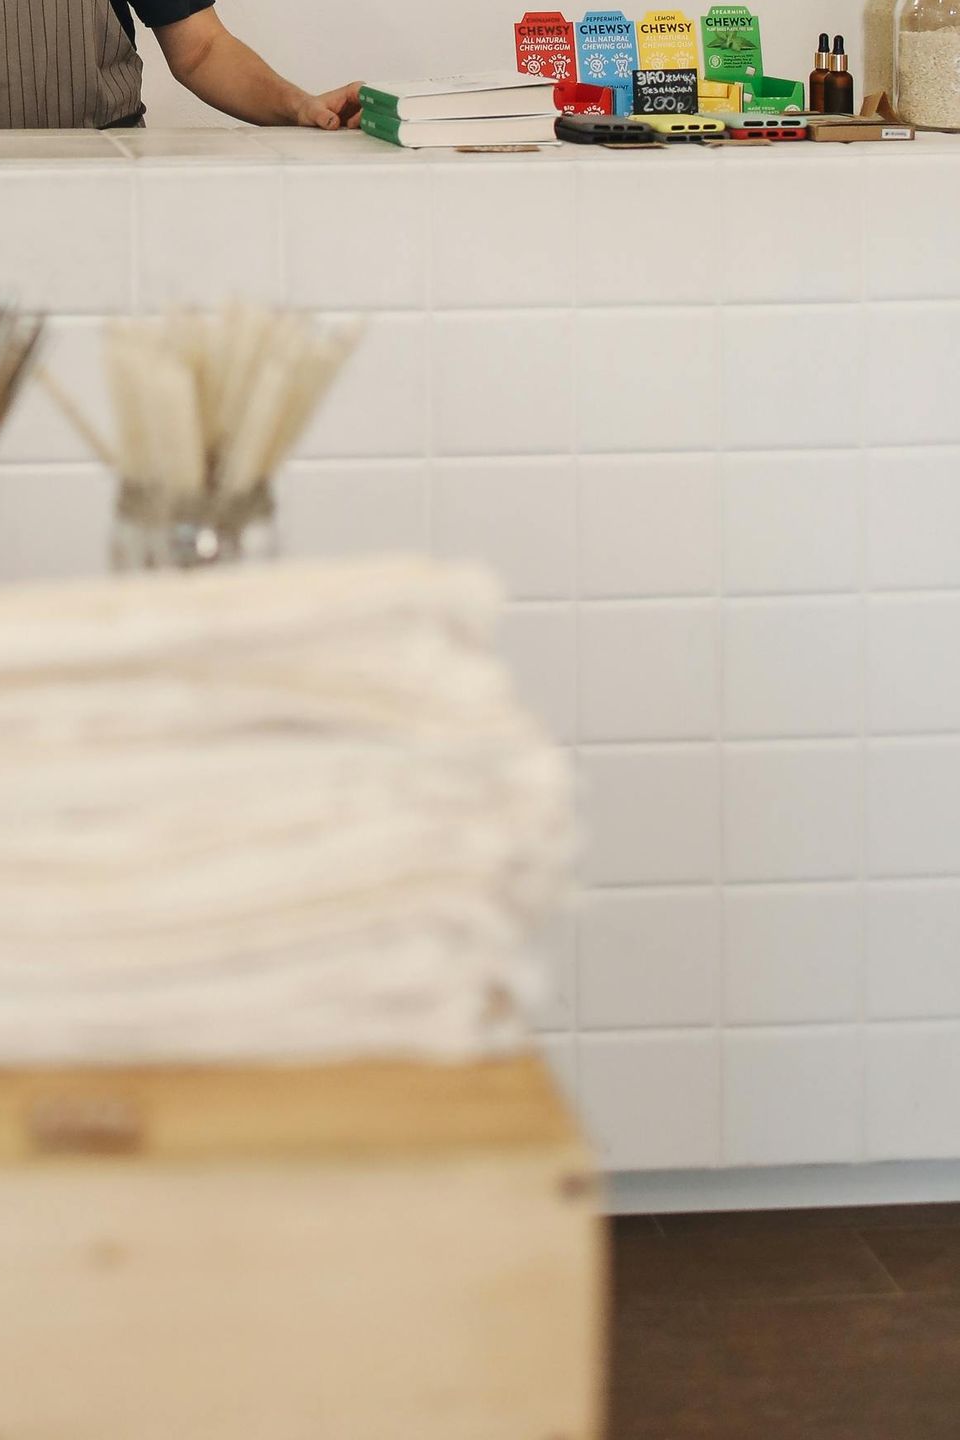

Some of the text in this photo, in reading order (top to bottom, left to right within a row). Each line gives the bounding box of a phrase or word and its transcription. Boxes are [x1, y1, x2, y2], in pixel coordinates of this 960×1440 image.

[705, 17, 753, 27] CHEWSY
[518, 25, 570, 36] CHEWSY
[580, 24, 631, 34] CHEWSY
[640, 23, 691, 33] CHEWSY
[523, 36, 535, 44] ALL
[585, 35, 597, 43] ALL
[521, 54, 546, 66] PLASTIC
[549, 53, 571, 63] SUGAR
[584, 53, 609, 65] PLASTIC
[611, 53, 633, 62] SUGAR
[551, 71, 570, 79] FREE
[637, 71, 665, 85] ЭКО
[584, 105, 605, 114] SUGAR
